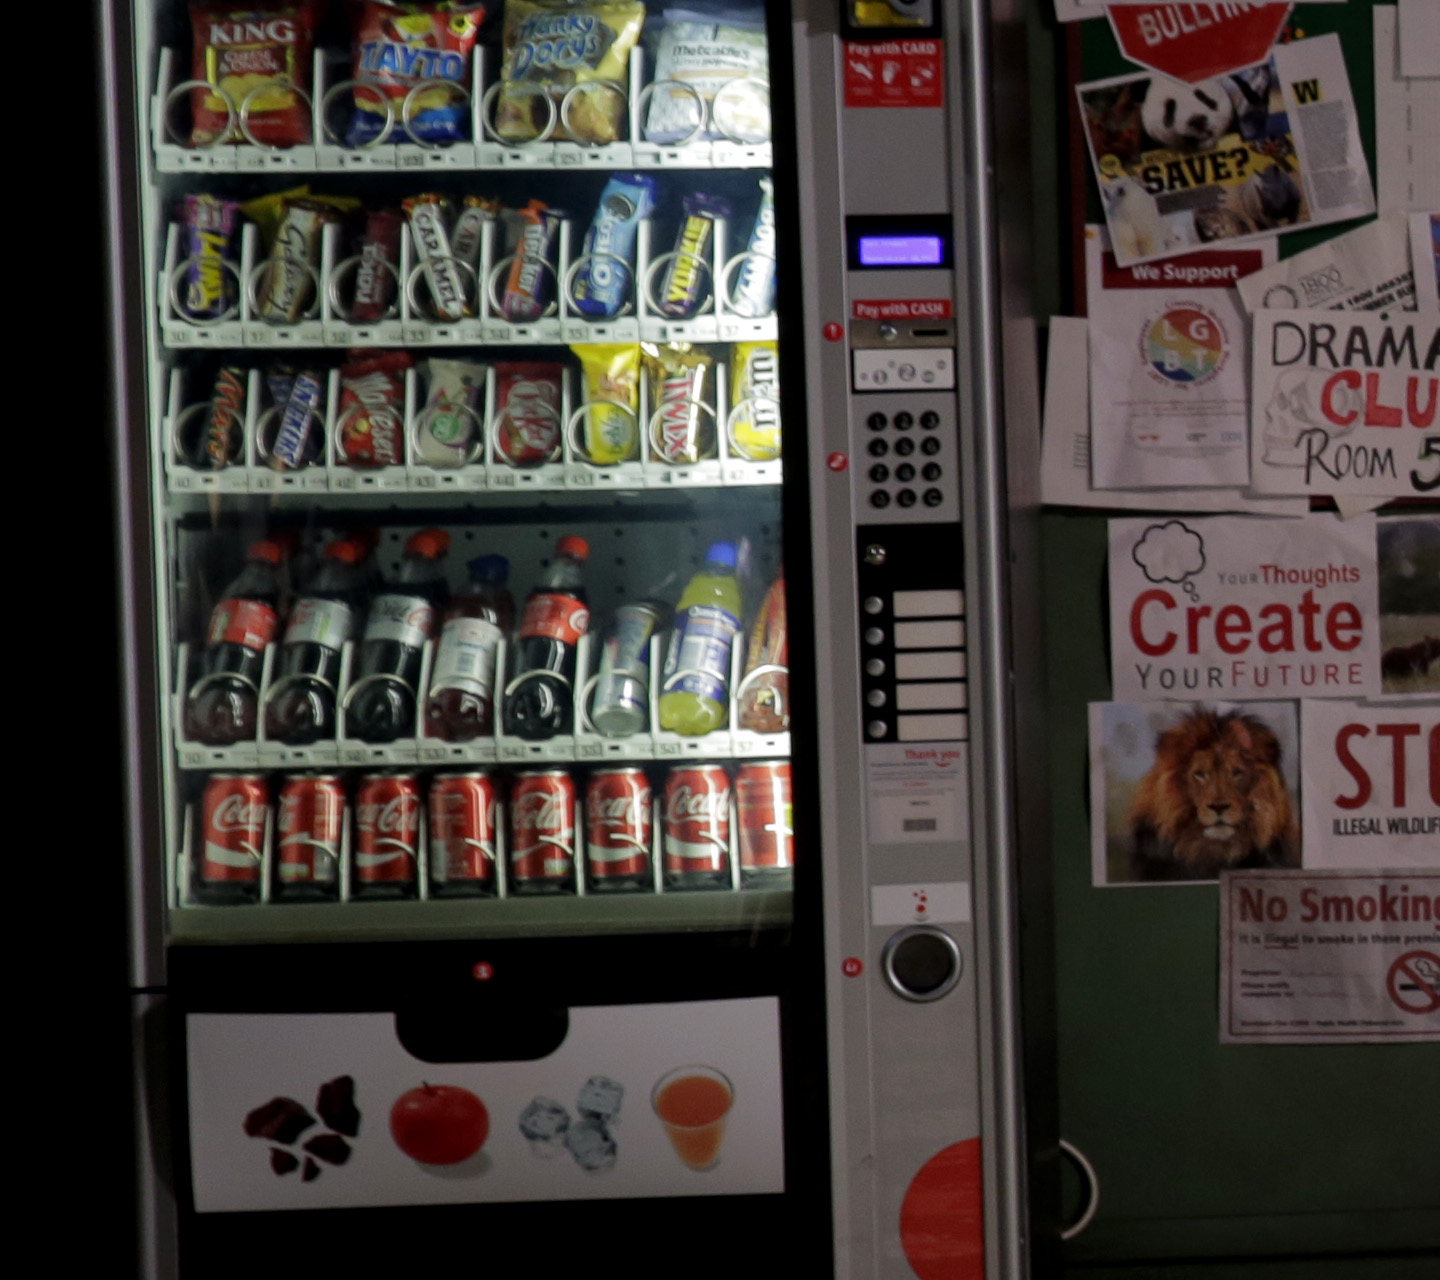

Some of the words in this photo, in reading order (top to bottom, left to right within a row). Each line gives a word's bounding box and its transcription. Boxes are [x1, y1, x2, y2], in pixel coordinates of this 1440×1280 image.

[210, 19, 297, 45] KING
[1137, 2, 1270, 47] BULLYIN
[359, 39, 464, 83] TAYTO
[848, 41, 871, 57] Pay
[871, 41, 901, 55] with
[902, 41, 937, 56] CARD
[1293, 80, 1321, 104] W
[1141, 146, 1250, 194] SAVE?
[413, 212, 463, 313] CARAMEL
[667, 215, 711, 302] YORKIE
[1132, 267, 1161, 280] We
[1164, 264, 1239, 283] Support
[857, 302, 879, 318] Pay
[880, 302, 909, 315] with
[910, 301, 944, 315] CASH
[1163, 319, 1177, 341] L
[1188, 318, 1210, 341] G
[662, 368, 696, 459] TWIX
[1217, 573, 1258, 585] YOUR
[1259, 563, 1361, 589] Thoughts
[1130, 587, 1363, 657] Create
[1135, 663, 1224, 690] YOUR
[1231, 661, 1363, 688] FUTURE
[905, 748, 937, 760] Thank
[1333, 817, 1383, 836] ILLEGAL
[1239, 887, 1289, 923] No
[1264, 933, 1299, 947] illegal
[1317, 933, 1355, 944] smoke
[1357, 933, 1368, 944] in
[1371, 933, 1401, 944] these
